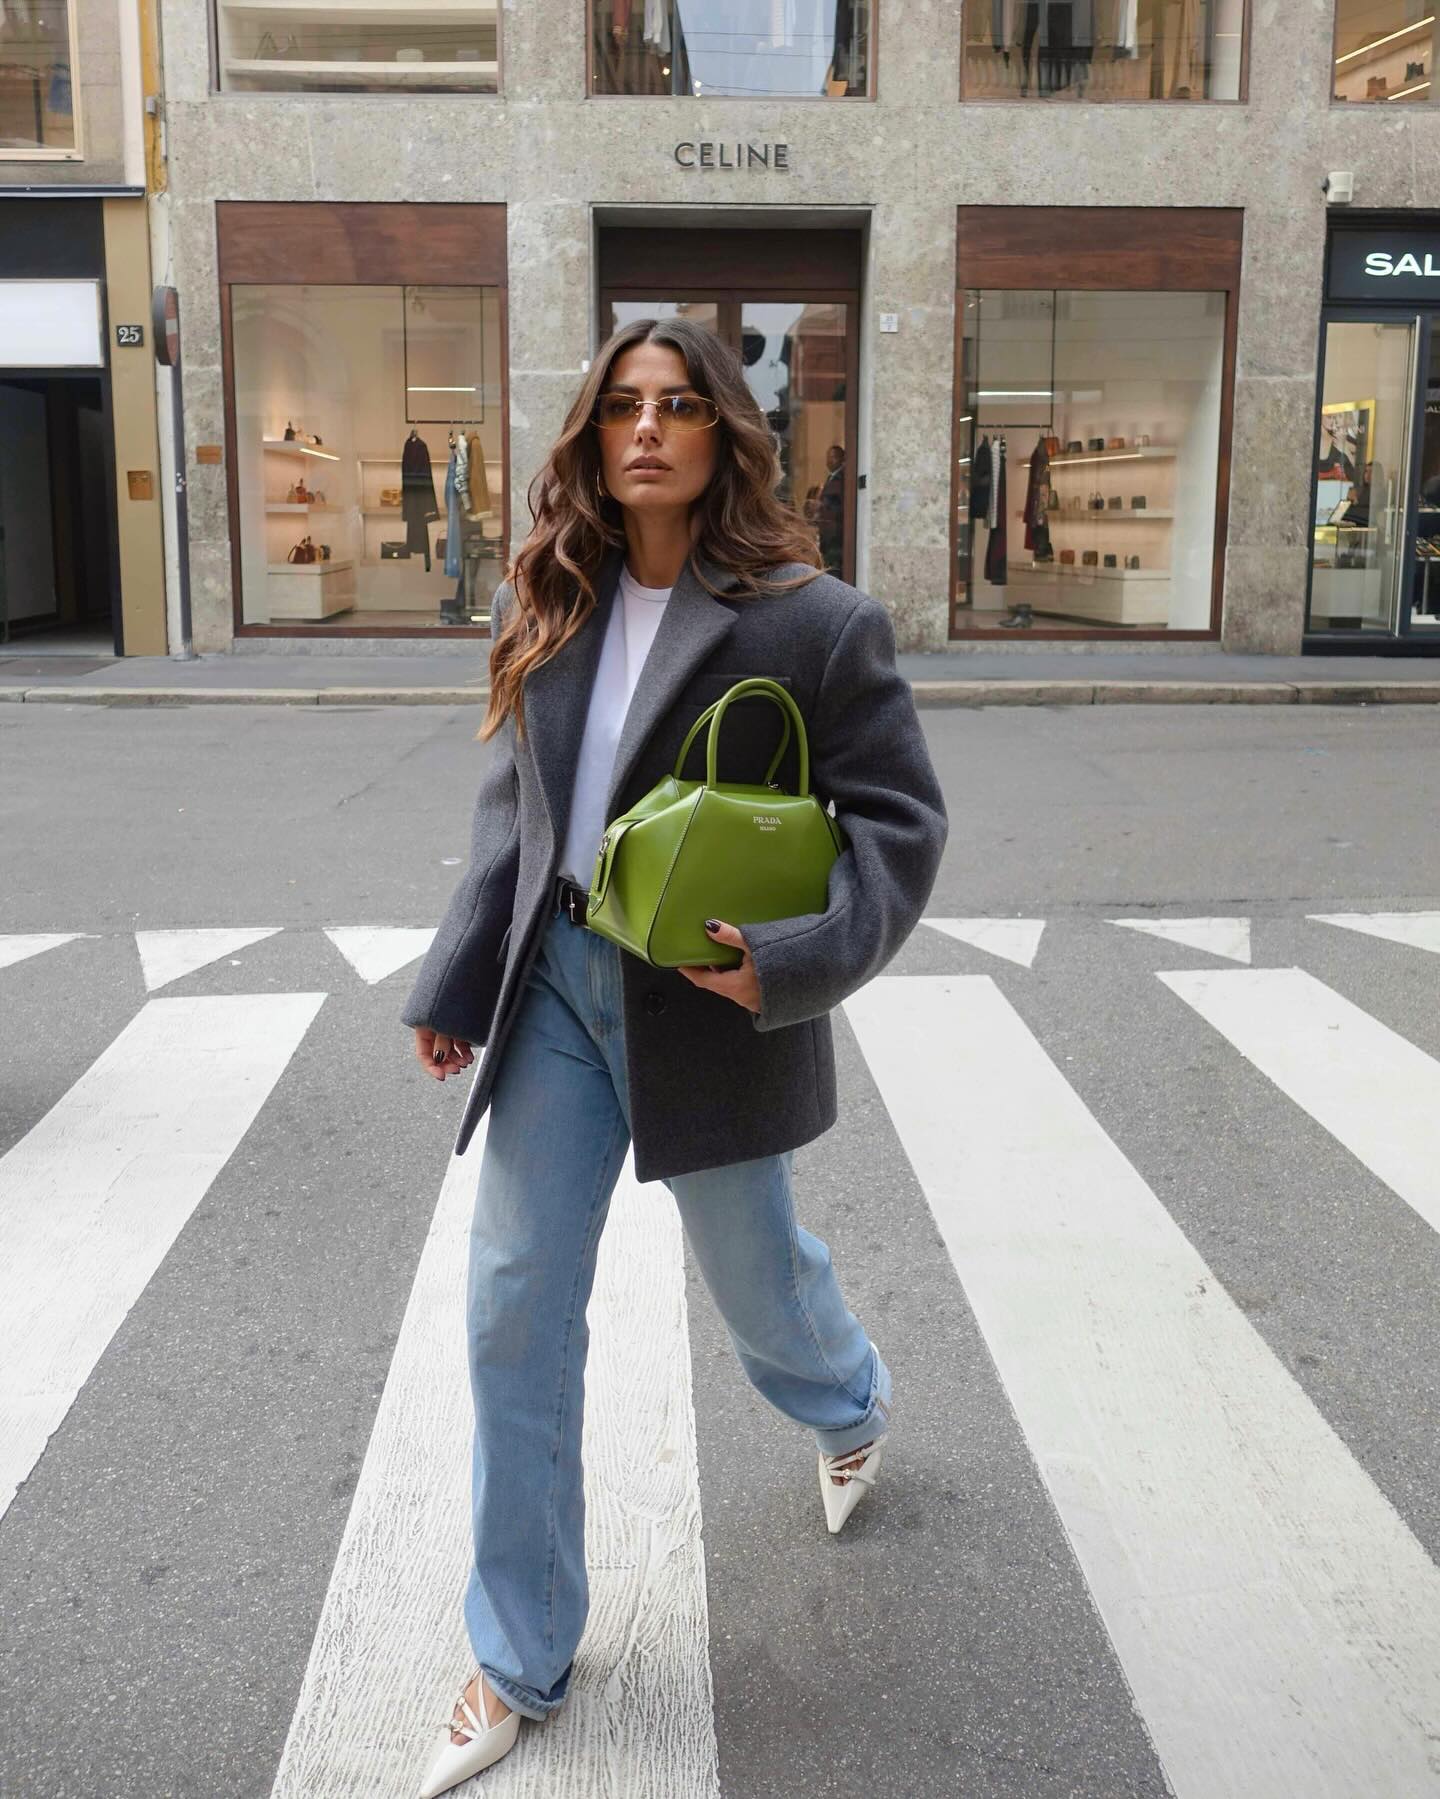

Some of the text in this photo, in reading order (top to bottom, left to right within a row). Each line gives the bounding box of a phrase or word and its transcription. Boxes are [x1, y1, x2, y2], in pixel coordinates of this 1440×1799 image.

[674, 142, 789, 168] CELINE
[1364, 252, 1440, 276] SAL
[118, 326, 140, 343] 25
[752, 815, 782, 825] PRADA
